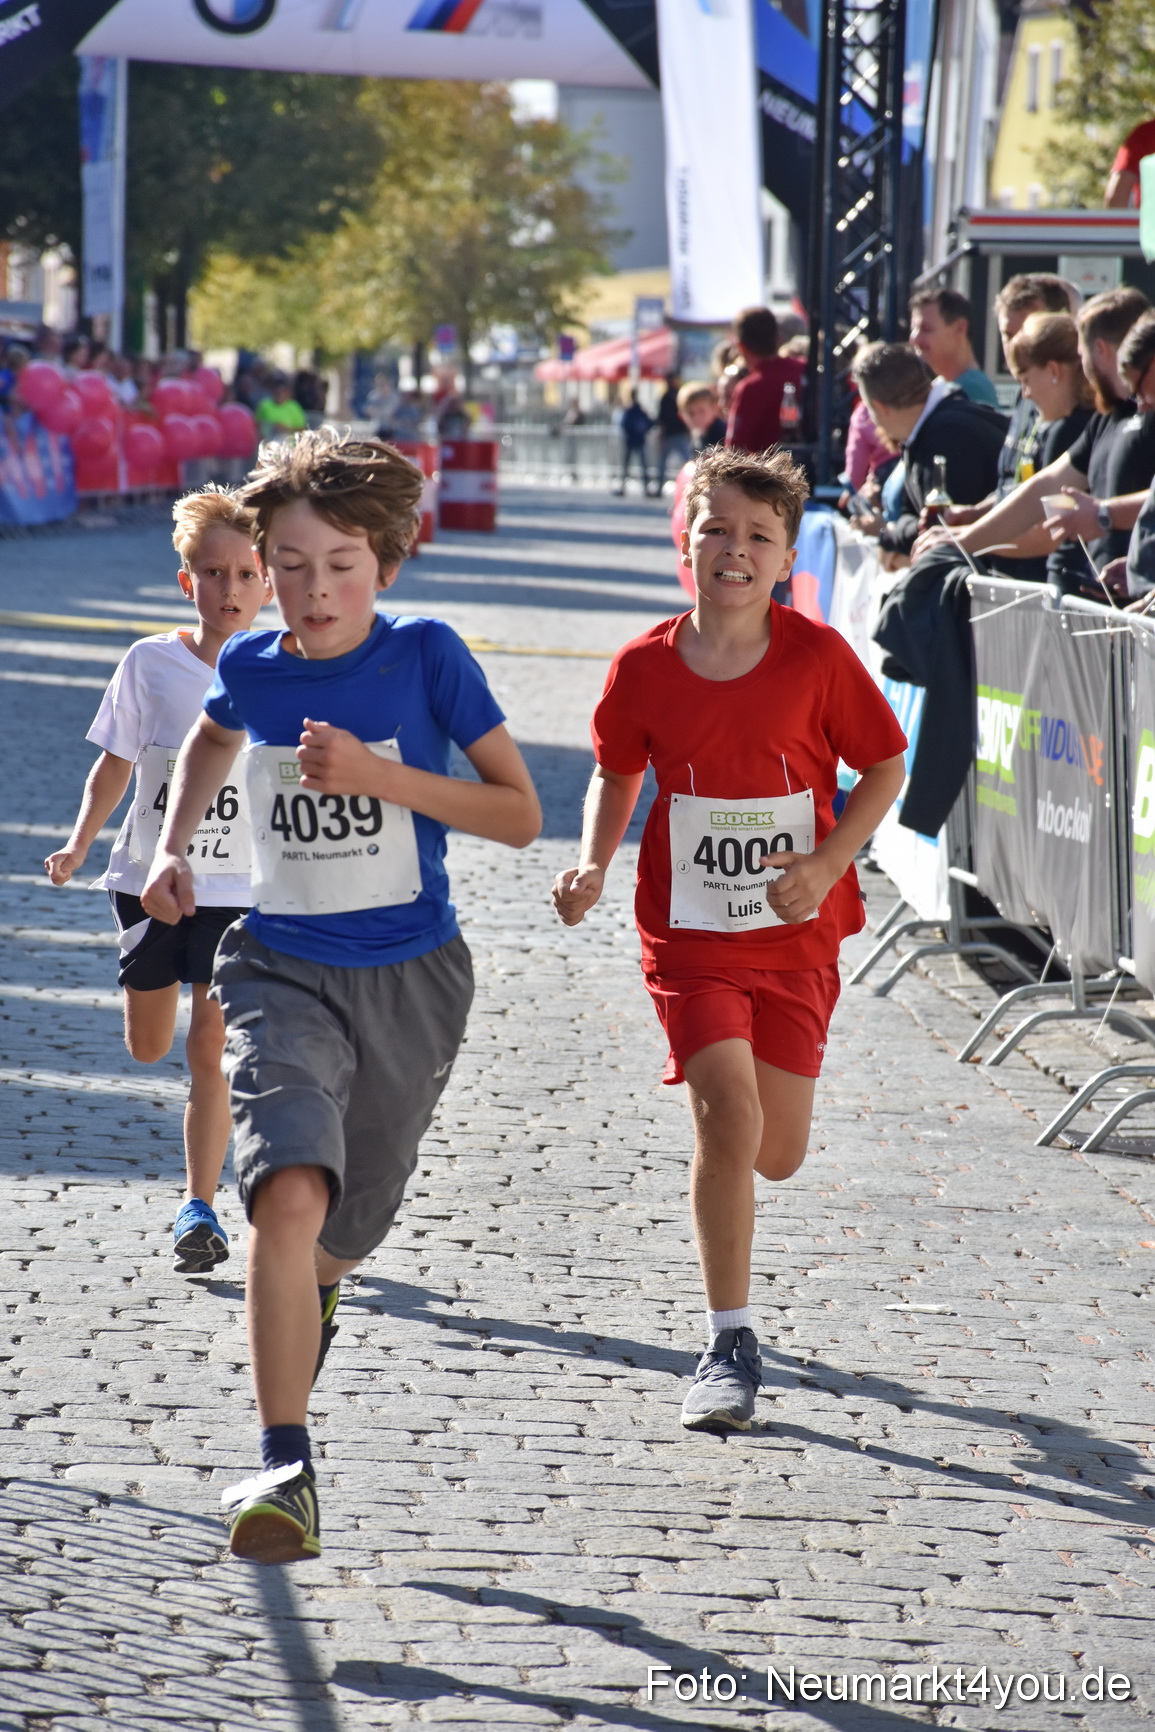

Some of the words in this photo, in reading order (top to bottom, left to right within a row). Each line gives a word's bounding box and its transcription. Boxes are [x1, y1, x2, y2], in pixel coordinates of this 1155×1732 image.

[270, 793, 383, 843] 4039
[710, 811, 776, 826] BOCK
[281, 850, 311, 862] PARTL
[312, 847, 363, 861] Neumarkt
[703, 880, 732, 892] PARTL
[727, 899, 763, 918] Luis
